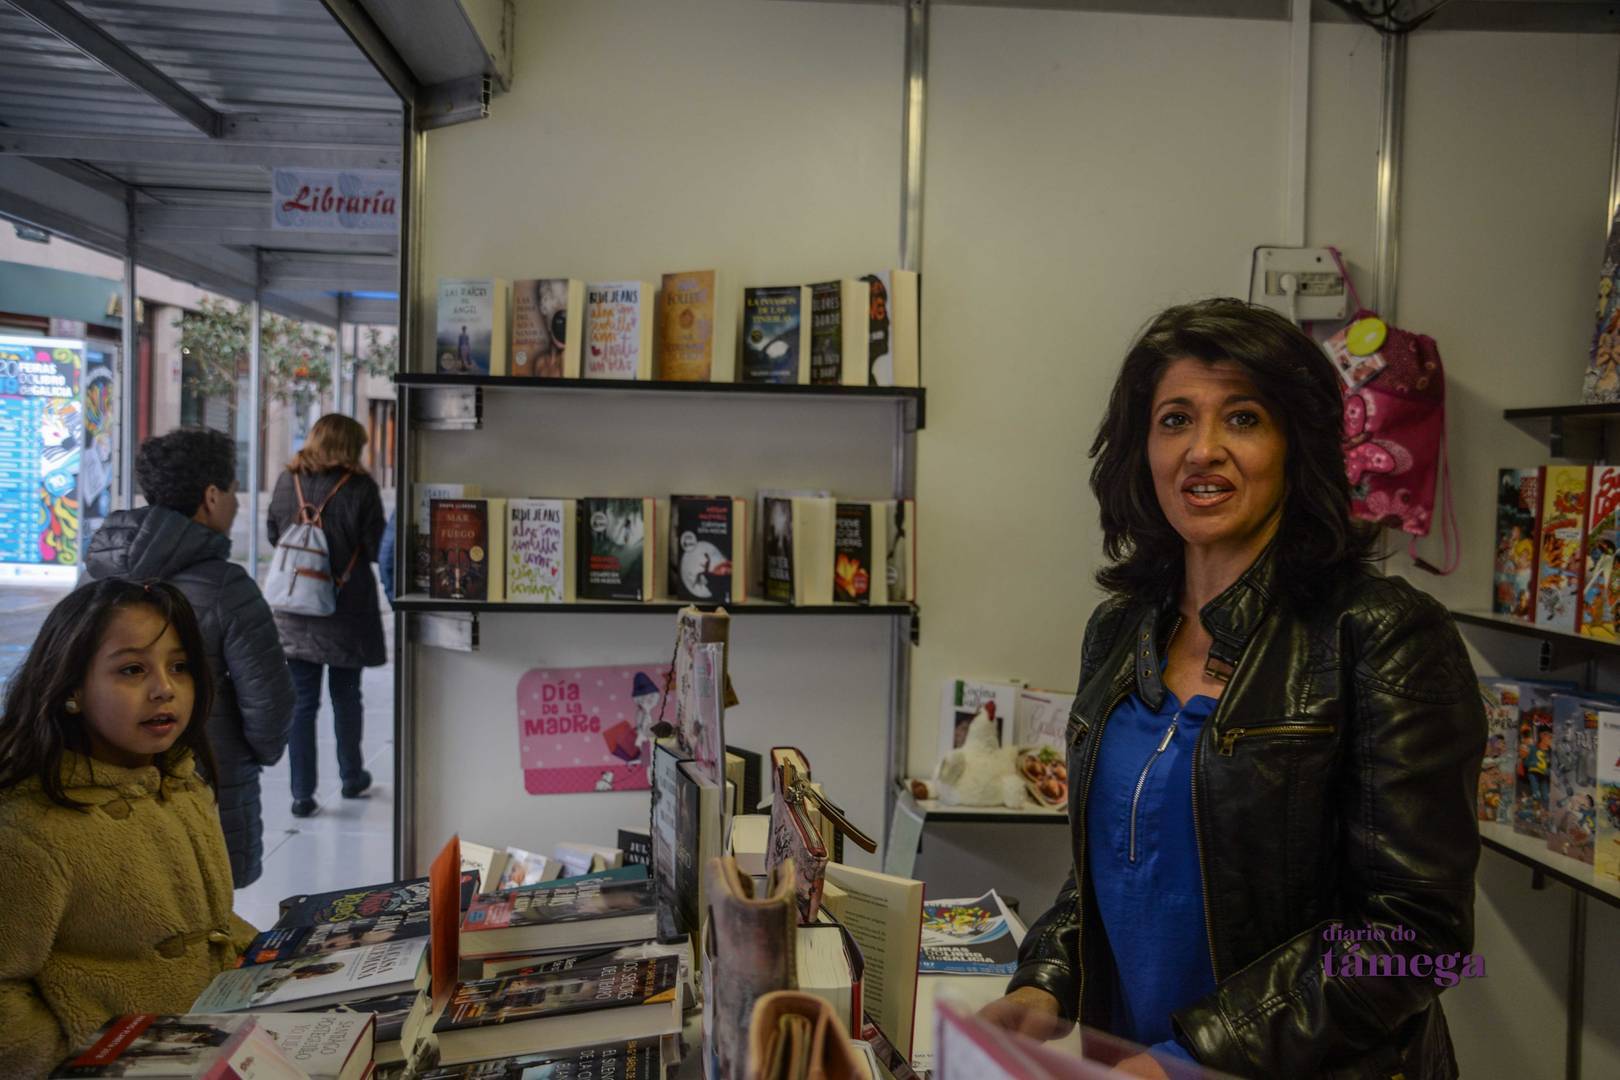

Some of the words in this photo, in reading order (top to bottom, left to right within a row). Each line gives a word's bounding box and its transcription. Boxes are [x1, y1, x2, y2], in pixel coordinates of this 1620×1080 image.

[283, 186, 395, 214] Libraría
[589, 290, 608, 304] BLUE
[611, 290, 638, 303] JEANS
[19, 362, 57, 375] FEIRAS
[446, 514, 470, 522] MAR
[512, 508, 530, 523] BLUE
[533, 508, 561, 523] JEANS
[441, 529, 476, 538] FUEGO
[601, 965, 618, 977] DEL
[595, 977, 616, 1000] TIEMPO
[617, 972, 638, 1000] SEÑORES
[580, 1049, 594, 1059] DE
[602, 1049, 617, 1057] EL
[579, 1060, 593, 1069] LA
